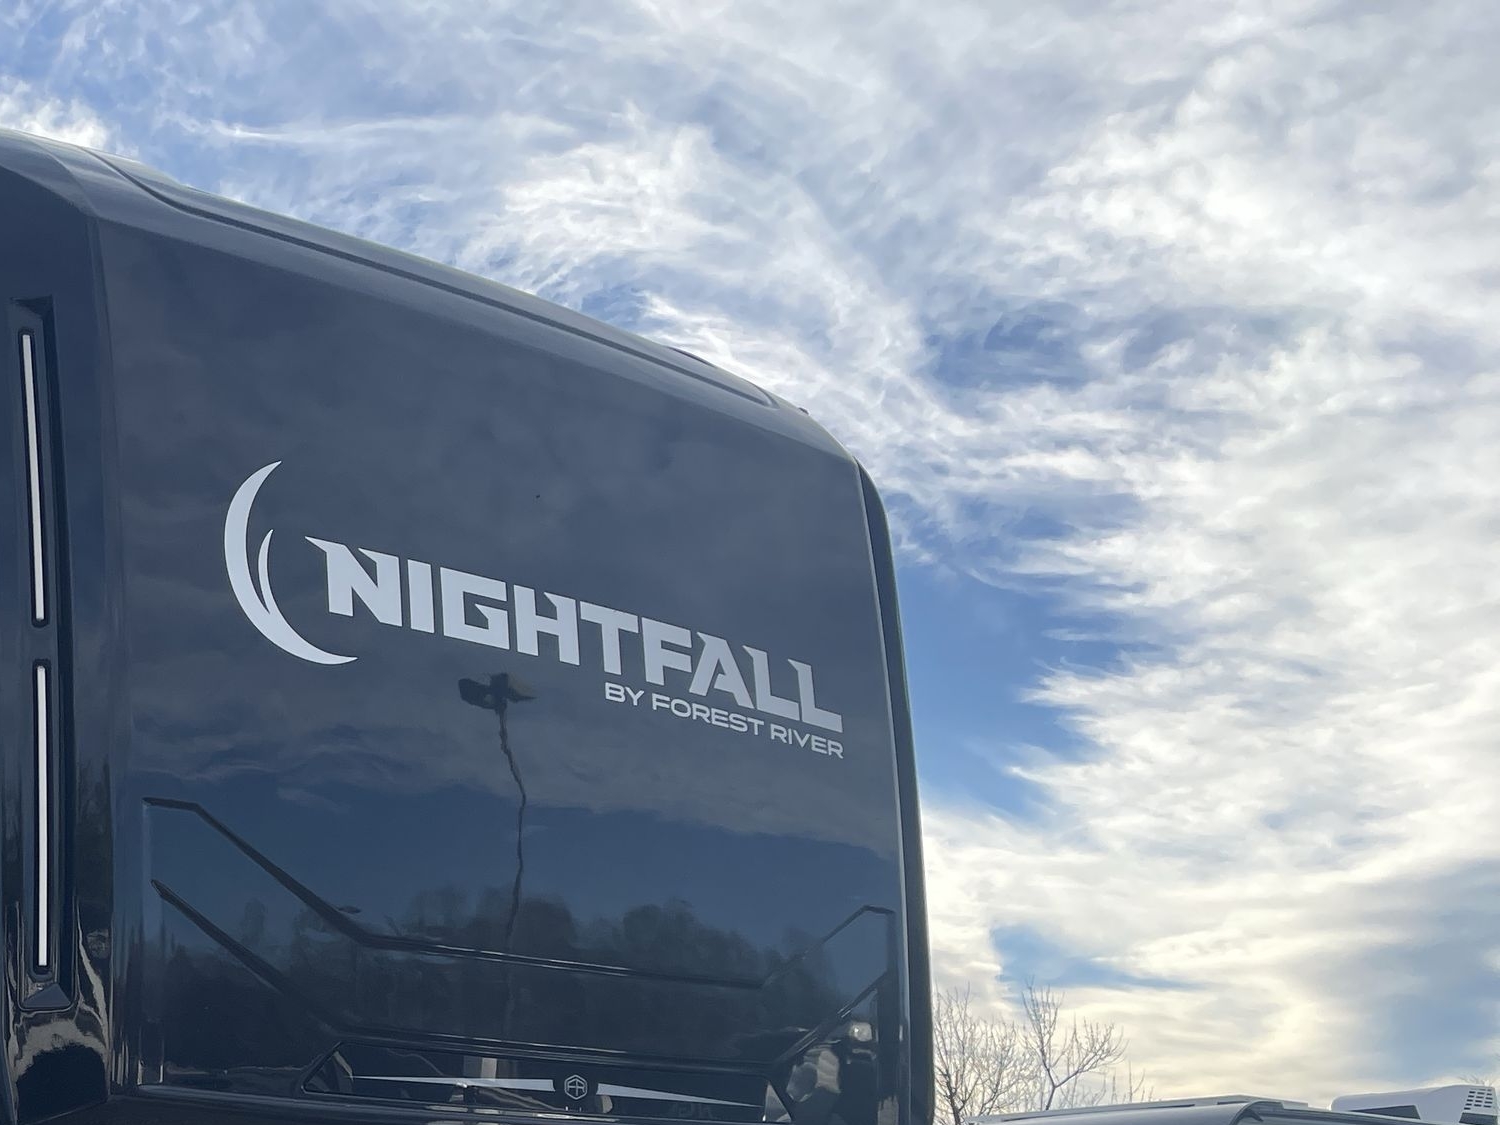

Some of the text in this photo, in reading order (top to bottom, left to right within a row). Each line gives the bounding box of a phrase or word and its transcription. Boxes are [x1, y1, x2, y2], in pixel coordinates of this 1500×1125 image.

[304, 535, 843, 732] NIGHTFALL
[604, 681, 844, 759] BY FOREST RIVER
